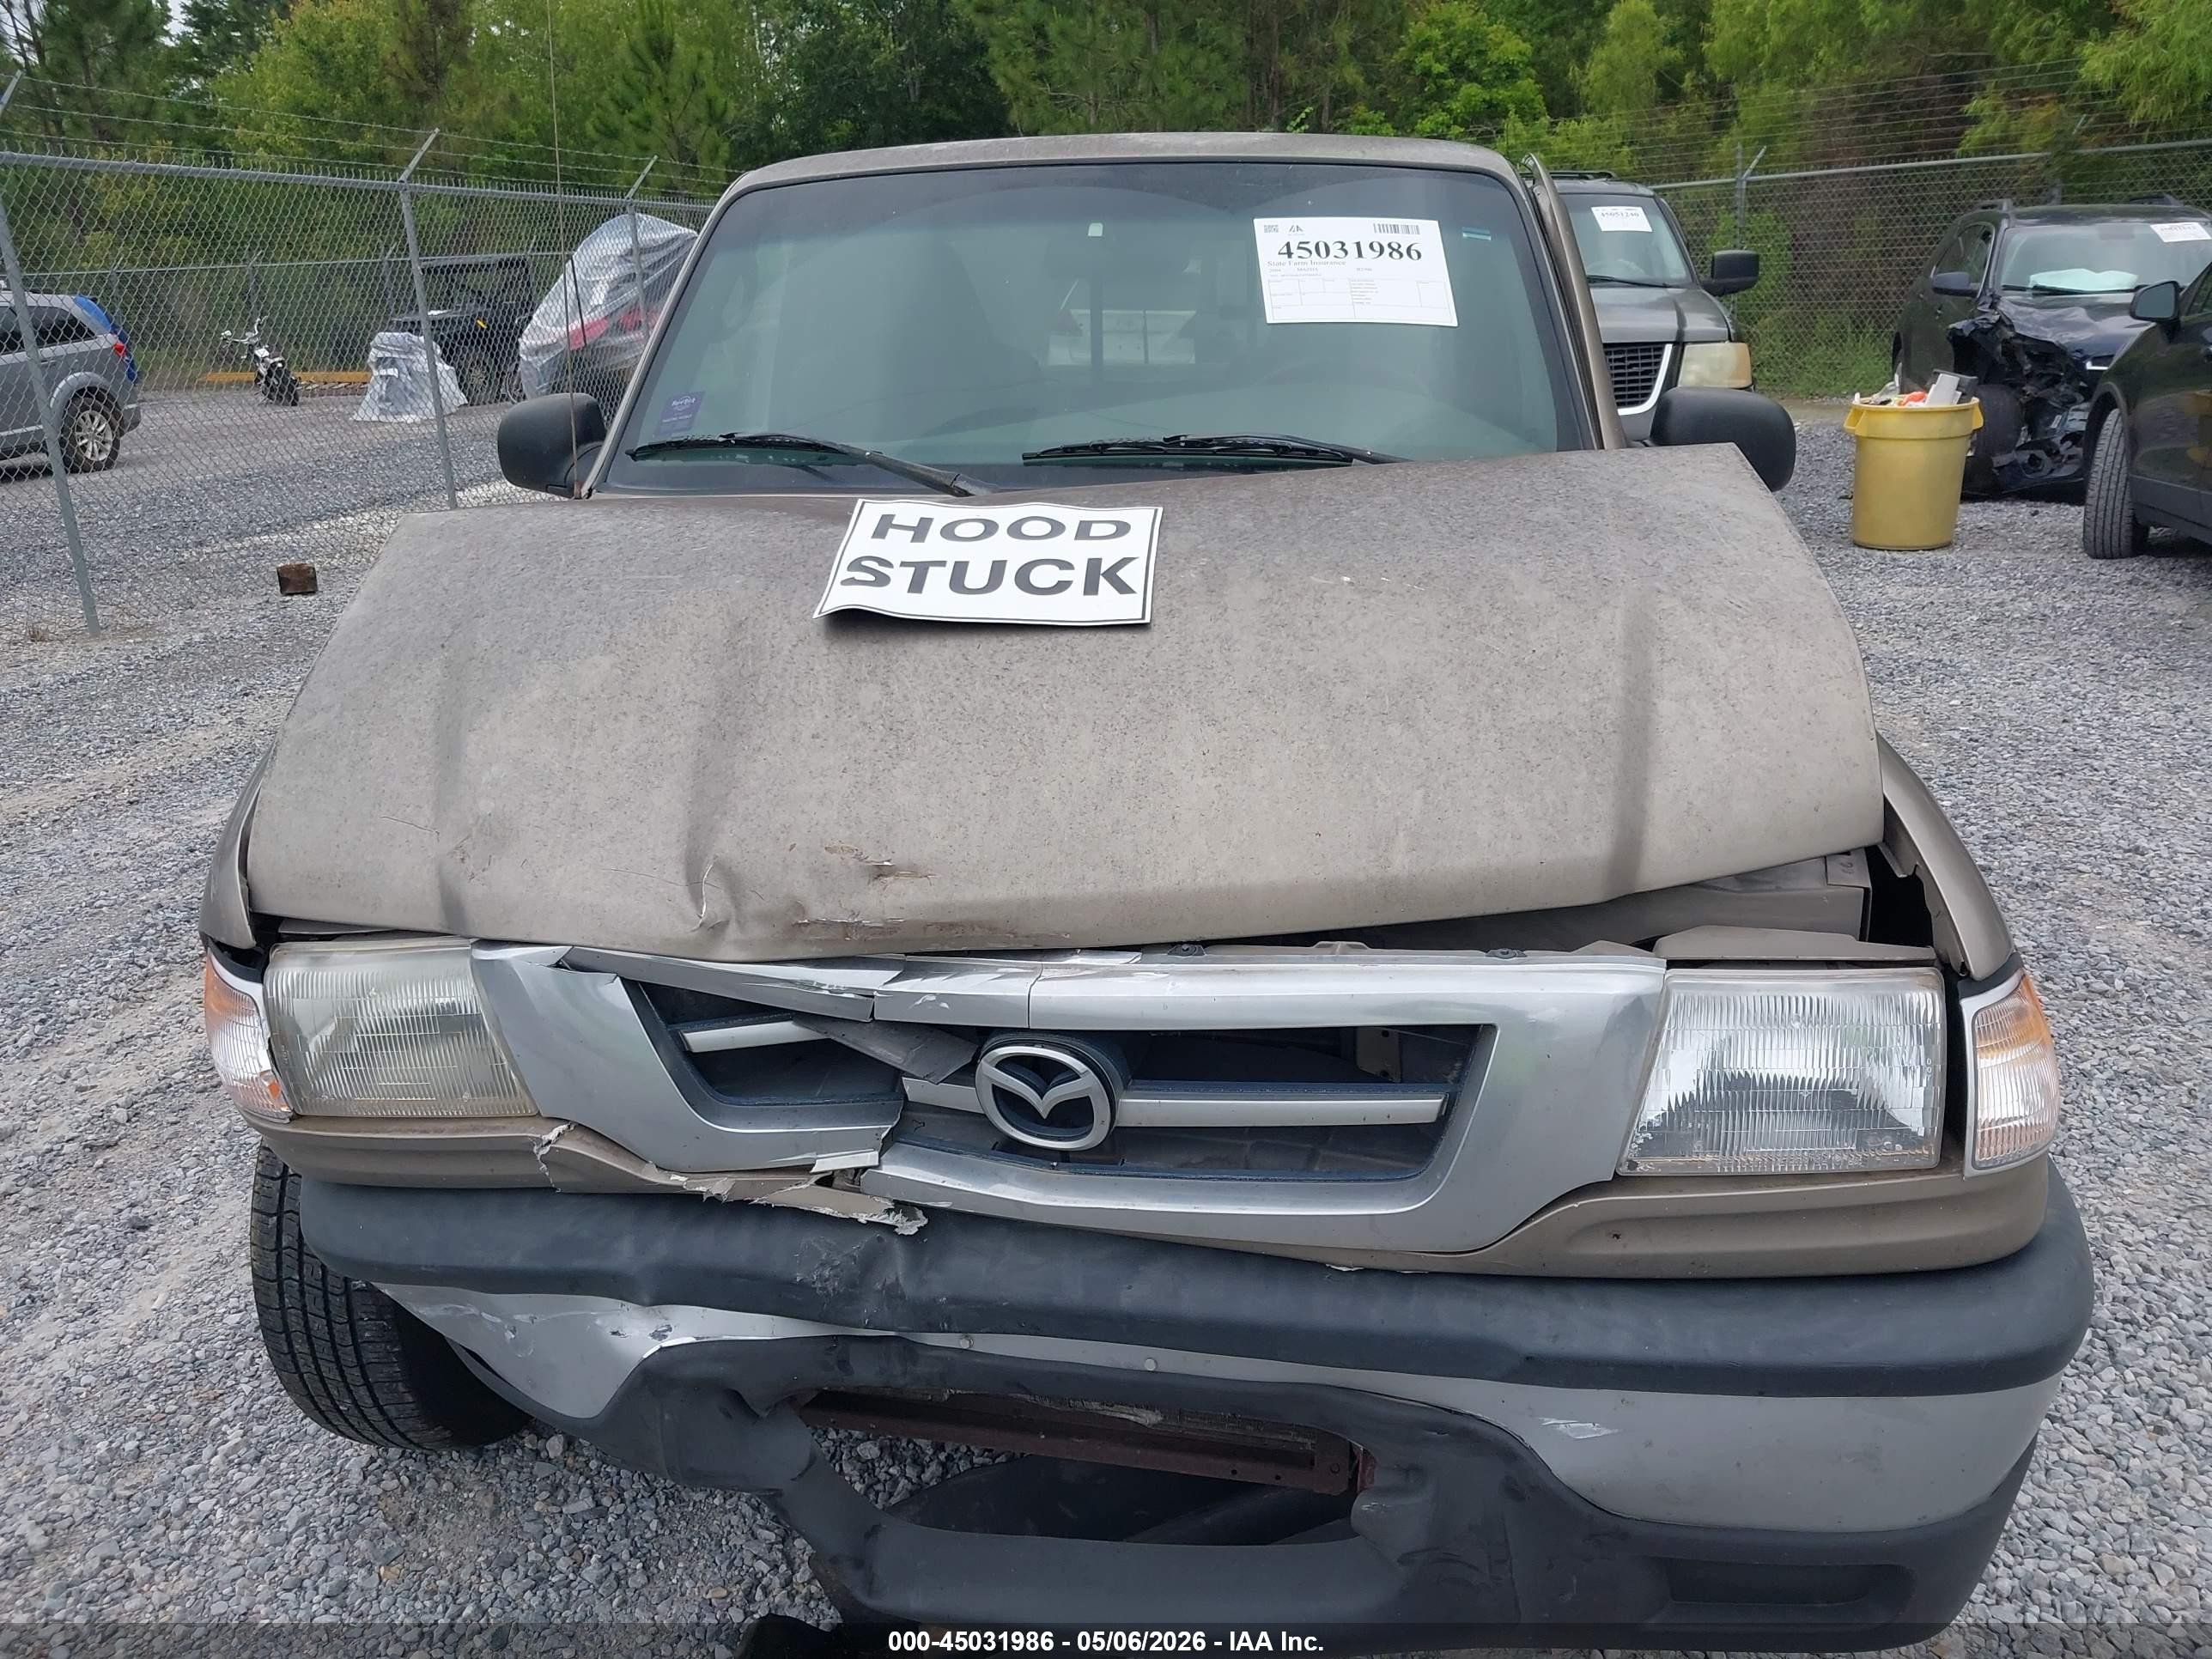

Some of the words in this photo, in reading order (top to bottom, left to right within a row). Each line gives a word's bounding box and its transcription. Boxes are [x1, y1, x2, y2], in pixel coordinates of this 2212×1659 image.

[1279, 241, 1421, 259] 45031986
[870, 514, 1132, 544] HOOD
[840, 556, 1139, 597] STUCK
